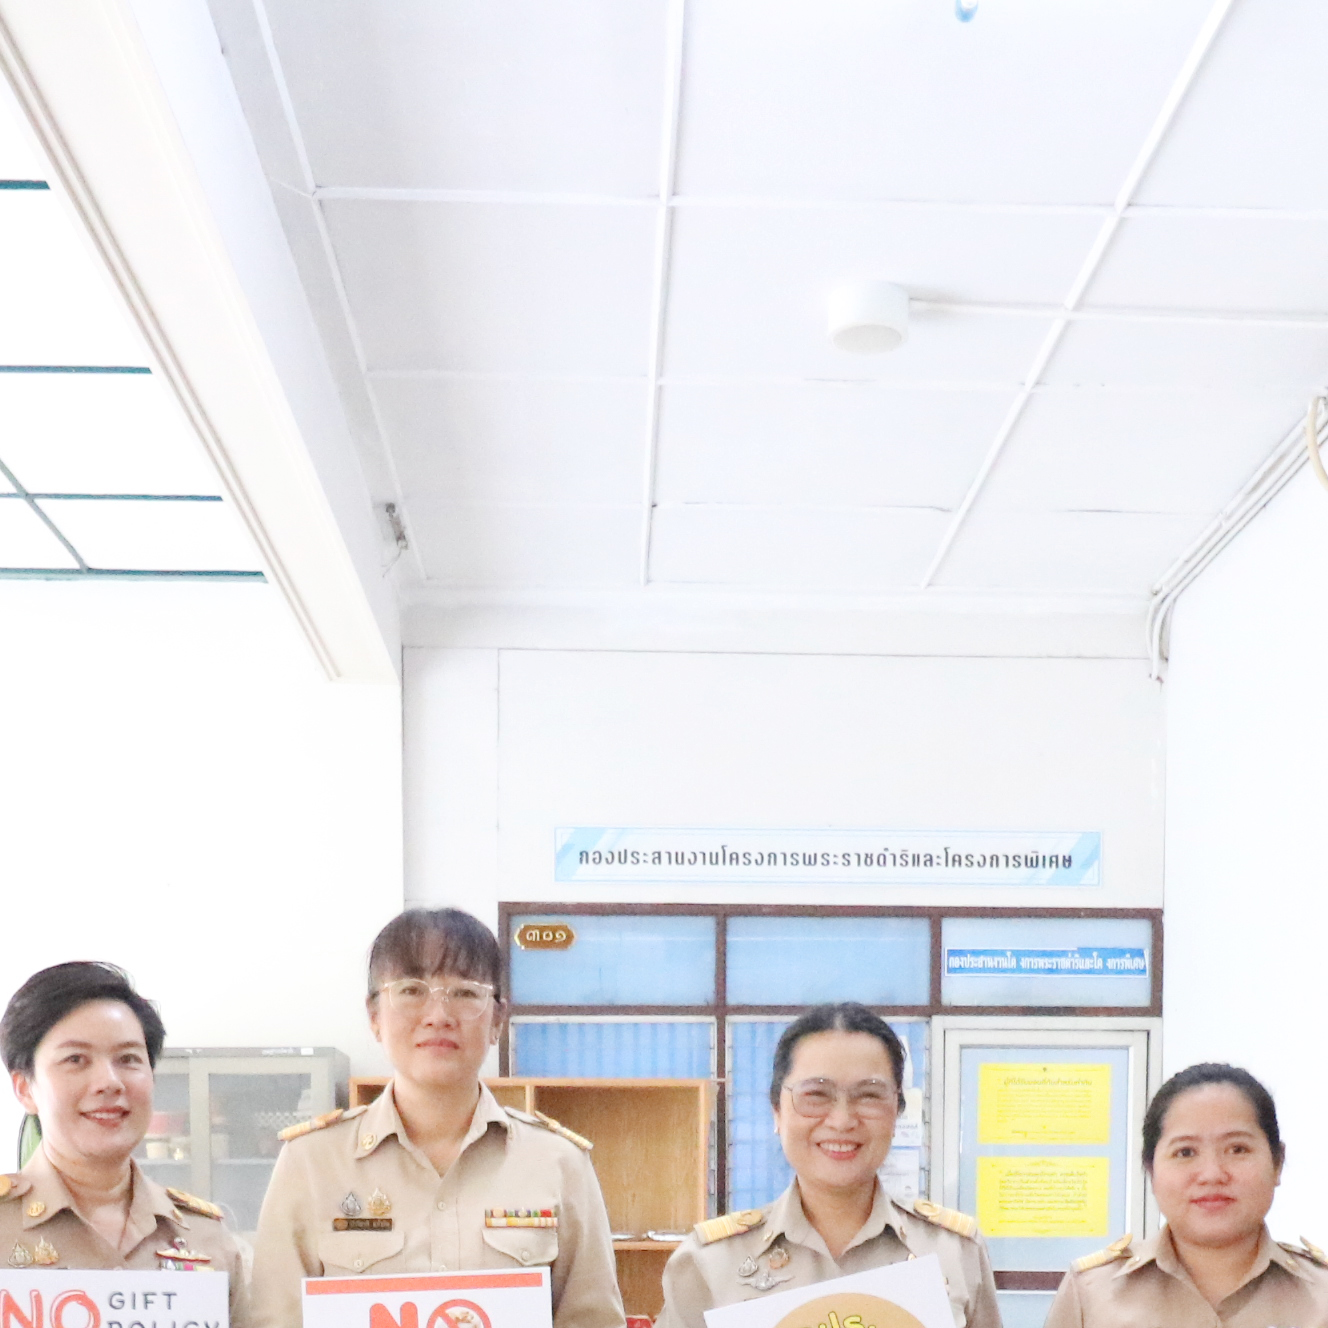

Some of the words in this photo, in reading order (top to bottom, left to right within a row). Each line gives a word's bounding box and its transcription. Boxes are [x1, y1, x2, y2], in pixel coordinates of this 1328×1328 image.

[578, 845, 1074, 869] กองประสานงานโครงการพระราชดำริและโครงการพิเศษ
[526, 929, 567, 943] ๓๐๑
[107, 1291, 178, 1311] GIFT
